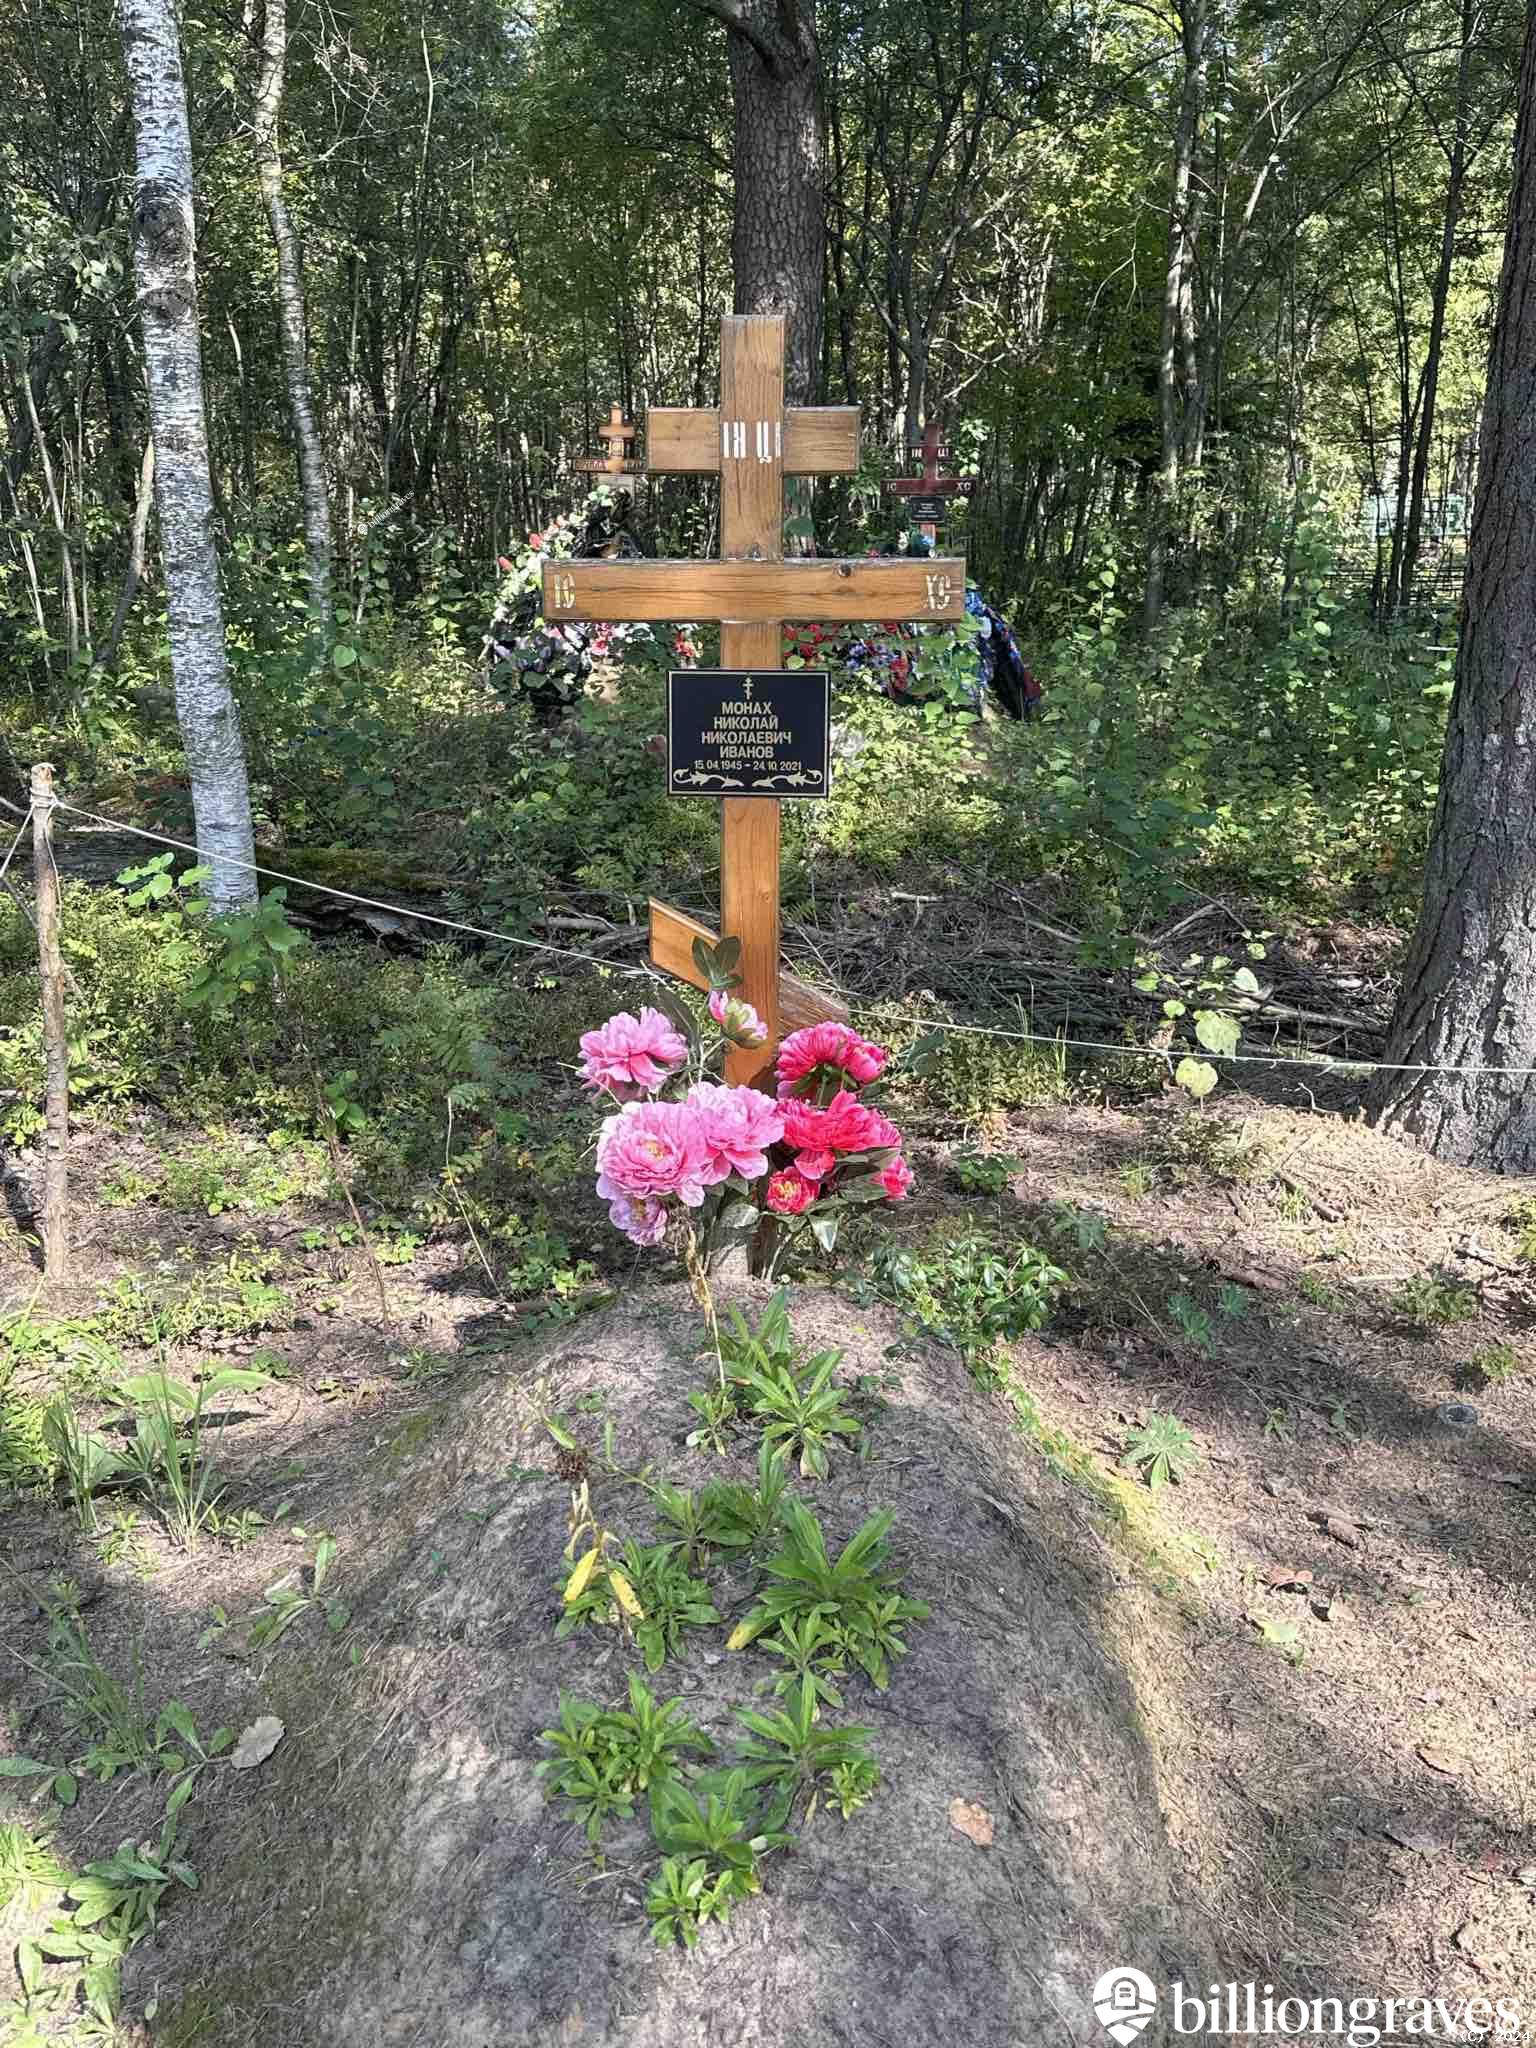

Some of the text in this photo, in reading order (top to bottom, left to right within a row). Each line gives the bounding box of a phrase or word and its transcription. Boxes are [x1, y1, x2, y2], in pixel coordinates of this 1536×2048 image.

[721, 702, 772, 715] МОНАХ
[713, 716, 778, 729] НИКОЛАЙ
[701, 731, 792, 744] НИКОЛАЕВИЧ
[719, 746, 774, 758] ИВАНОВ
